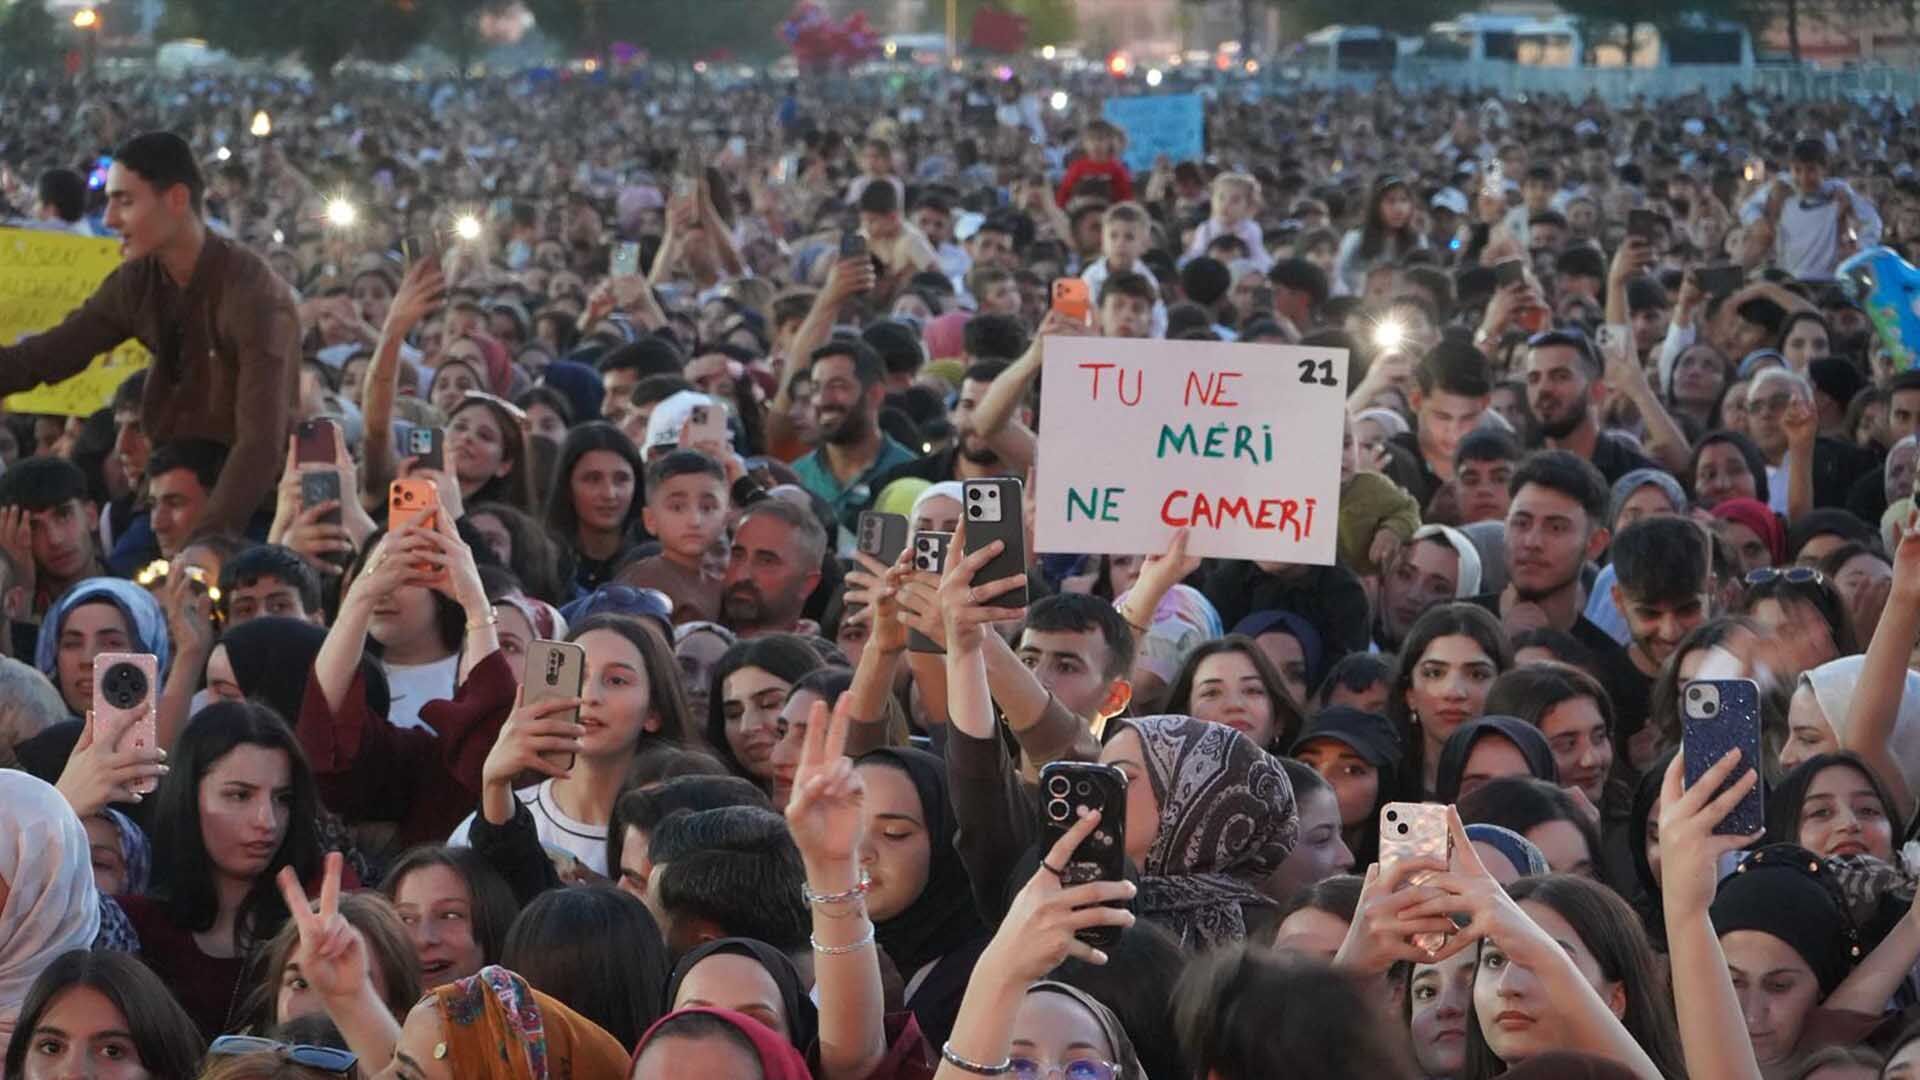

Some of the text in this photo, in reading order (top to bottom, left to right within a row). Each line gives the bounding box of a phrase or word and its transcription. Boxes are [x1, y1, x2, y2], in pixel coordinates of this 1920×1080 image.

[1078, 363, 1242, 407] TU NE
[1298, 359, 1337, 387] 21
[1067, 487, 1125, 522] NE
